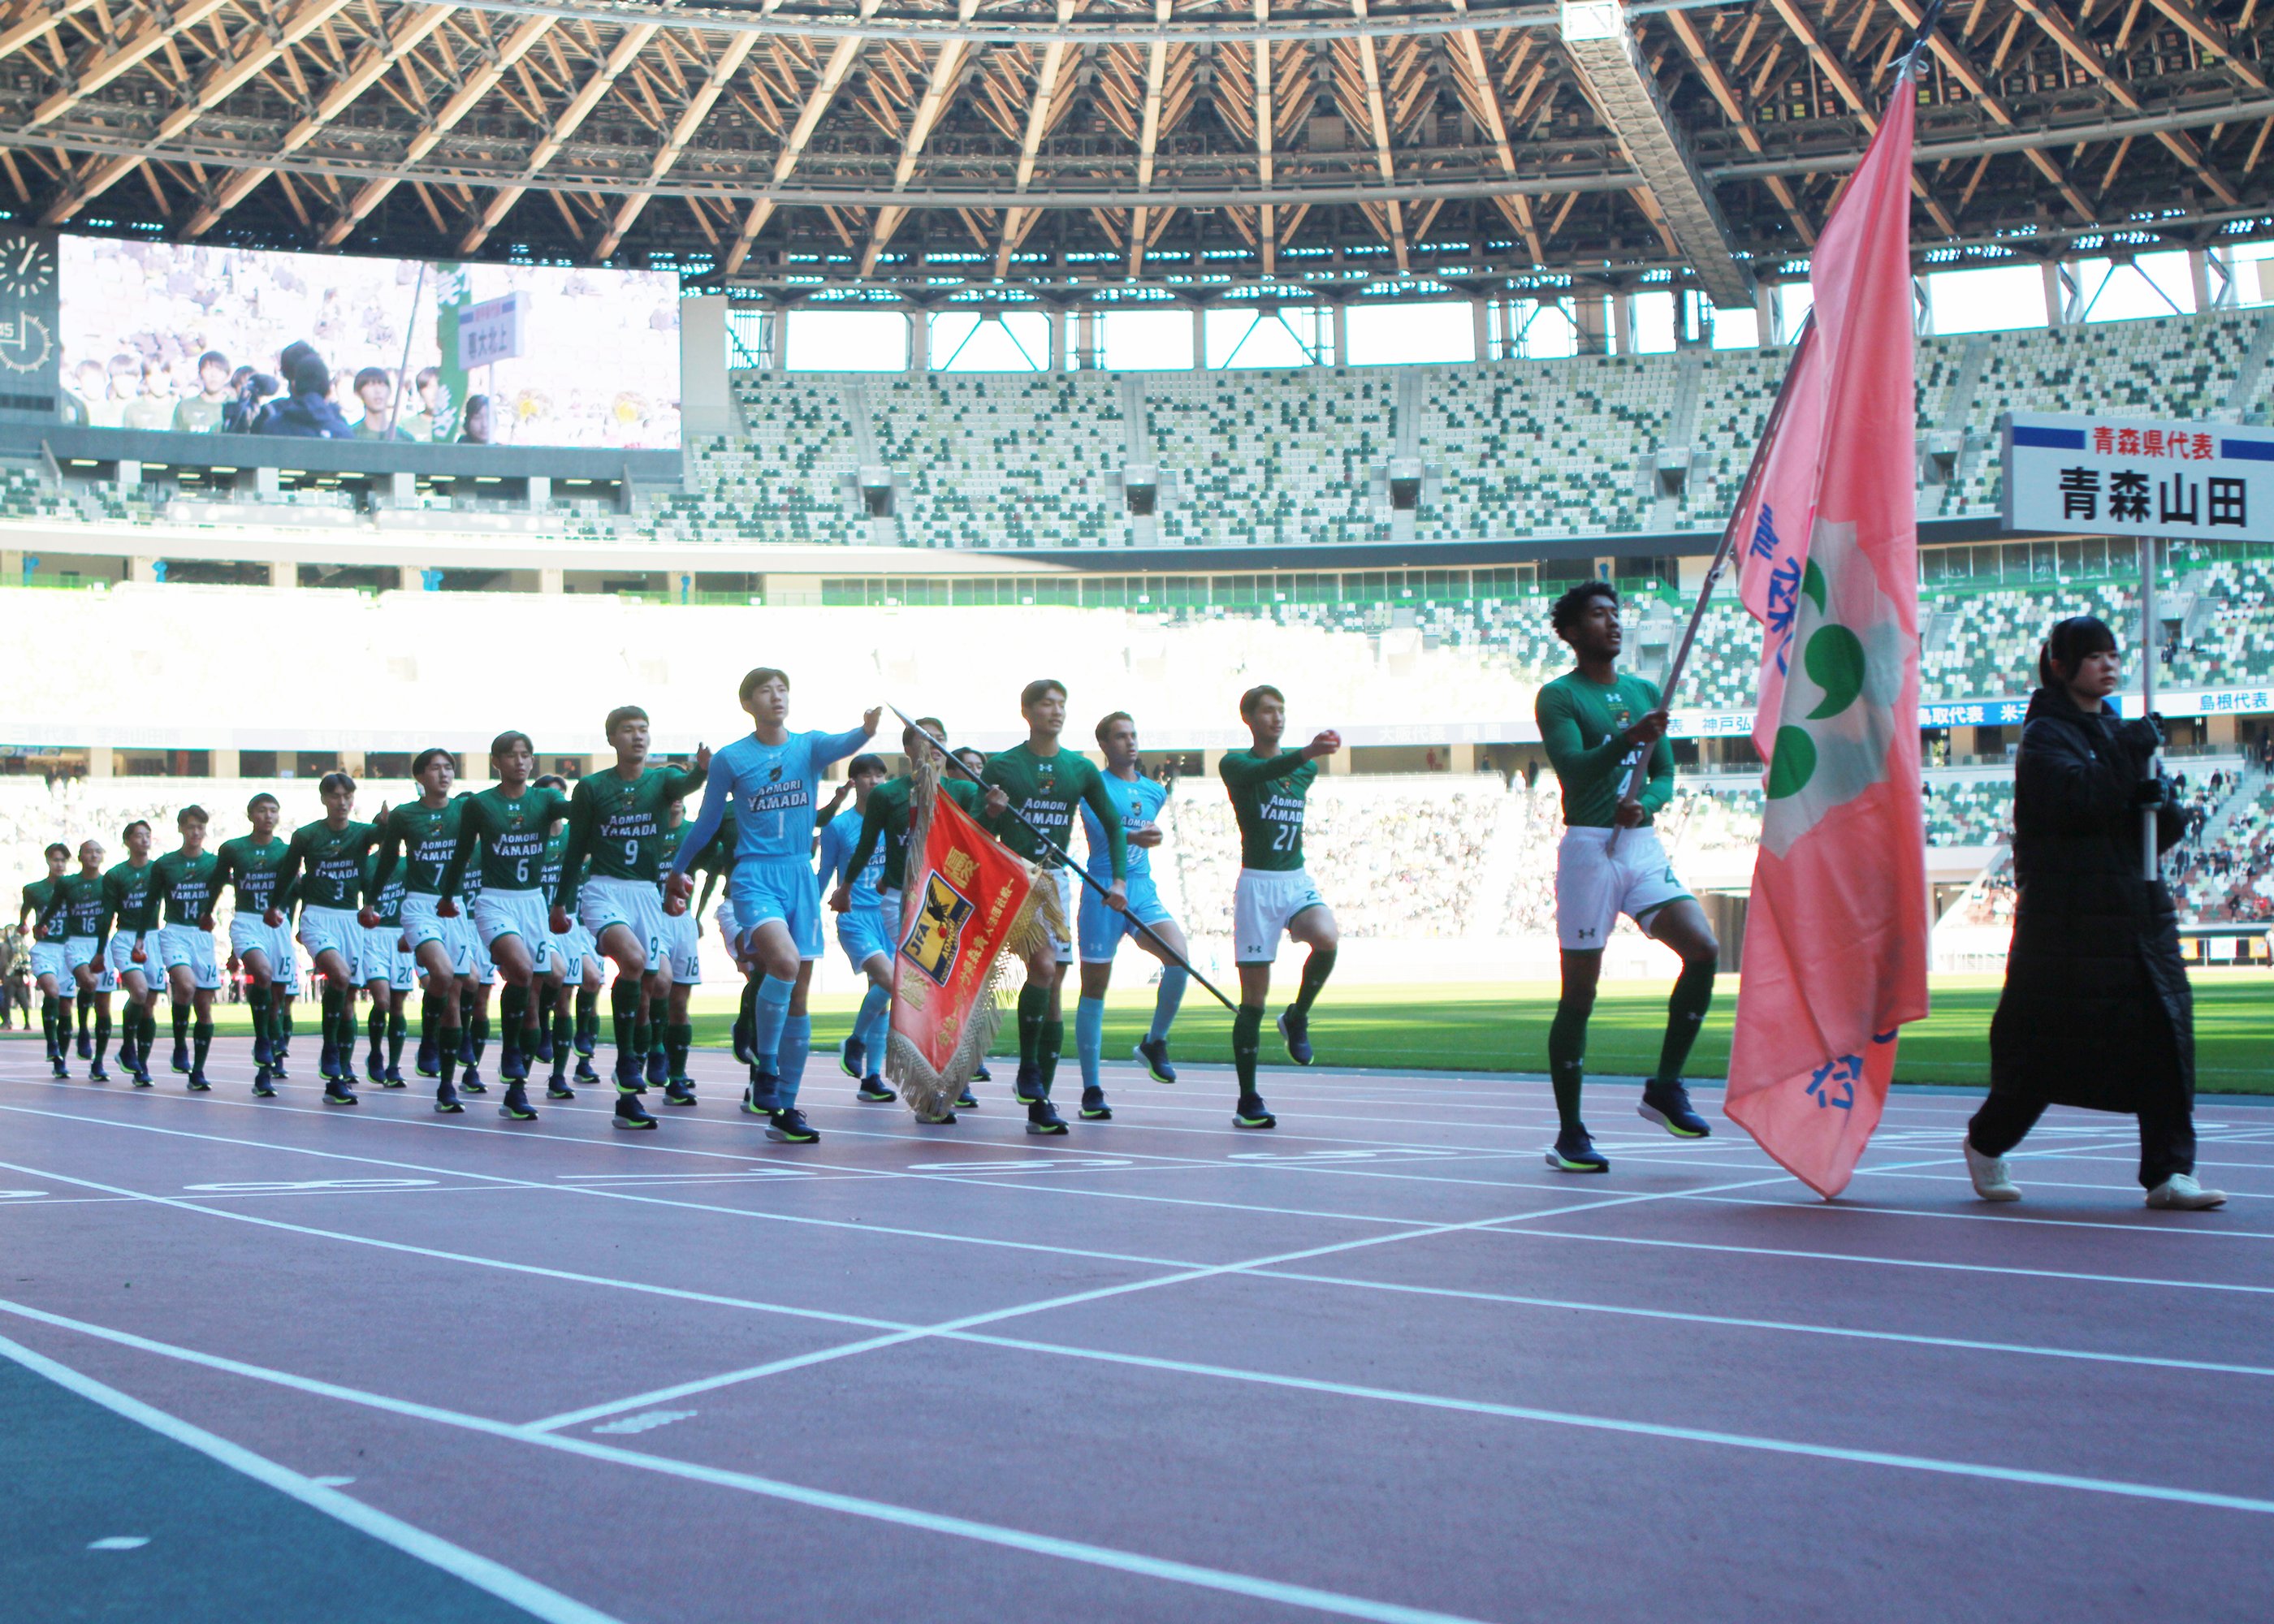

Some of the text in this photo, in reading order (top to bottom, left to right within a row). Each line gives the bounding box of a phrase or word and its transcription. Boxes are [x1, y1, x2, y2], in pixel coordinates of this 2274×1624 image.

[2093, 426, 2214, 460] 青森県代表
[2059, 466, 2246, 527] 青森山田
[2200, 692, 2268, 710] 島根代表
[1702, 716, 1756, 732] 神戸弘
[756, 780, 802, 797] AOMORI
[747, 792, 809, 812] YAMADA
[1023, 797, 1068, 811] AOMORI
[609, 813, 652, 826] AOMORI
[1260, 802, 1303, 823] YAMAD
[600, 823, 658, 837] YAMADA
[778, 811, 785, 840] 1
[421, 839, 456, 850] AOMORI
[499, 832, 539, 844] AOMORI
[1034, 827, 1050, 855] 5
[1273, 824, 1298, 851] 21
[492, 843, 543, 856] YAMADA
[625, 840, 639, 866] 9
[319, 859, 354, 870] AOMORI
[517, 858, 529, 883] 6
[434, 863, 445, 887] 7
[863, 866, 880, 889] 12
[1664, 866, 1680, 888] 4
[176, 882, 206, 890] AOMORI
[239, 880, 275, 890] YAMAD
[334, 881, 344, 901] 3
[123, 900, 143, 909] YAM
[171, 890, 210, 900] YAMADA
[253, 892, 269, 910] 15
[184, 901, 199, 919] 14
[380, 900, 398, 918] 20
[48, 919, 64, 935] 23
[83, 917, 96, 934] 16
[812, 918, 819, 947] 1
[651, 936, 659, 961] 9
[910, 923, 931, 957] JFA
[940, 918, 957, 961] AOMORI
[456, 945, 467, 966] 7
[535, 941, 546, 964] 6
[206, 964, 218, 983] 14
[279, 956, 292, 975] 15
[351, 957, 359, 977] 3
[397, 966, 413, 984] 20
[567, 957, 580, 978] 10
[686, 956, 699, 977] 18
[102, 971, 115, 987] 16
